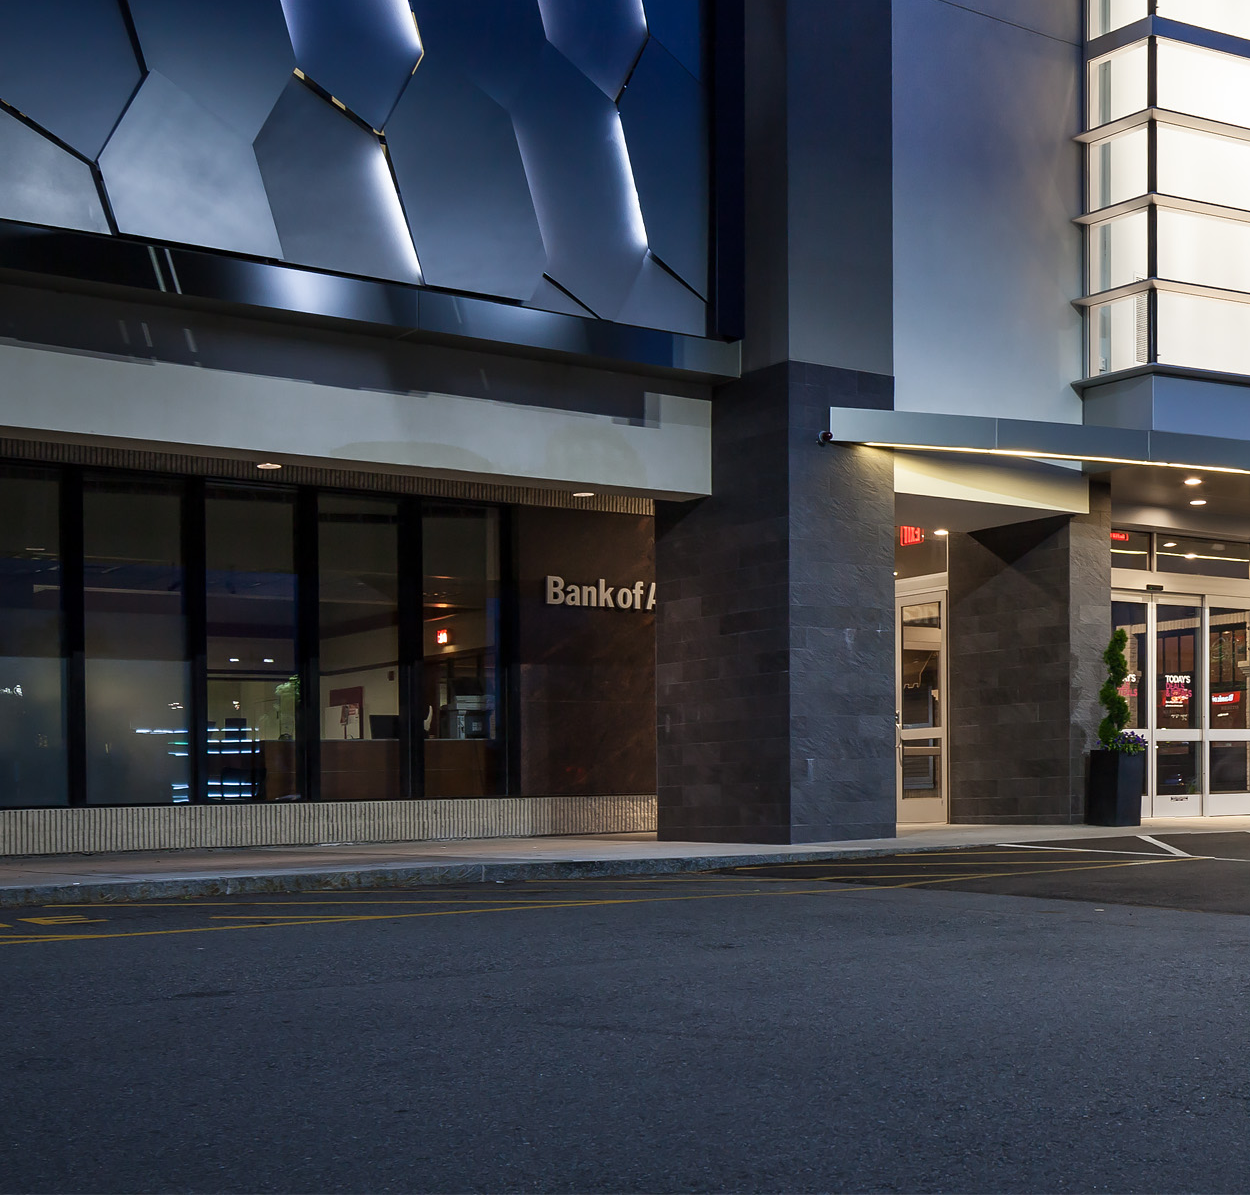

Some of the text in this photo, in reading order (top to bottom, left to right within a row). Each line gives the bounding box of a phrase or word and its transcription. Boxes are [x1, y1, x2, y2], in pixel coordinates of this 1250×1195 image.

[546, 575, 615, 608] Bank
[617, 581, 644, 610] of
[1165, 675, 1191, 683] TODAY'S
